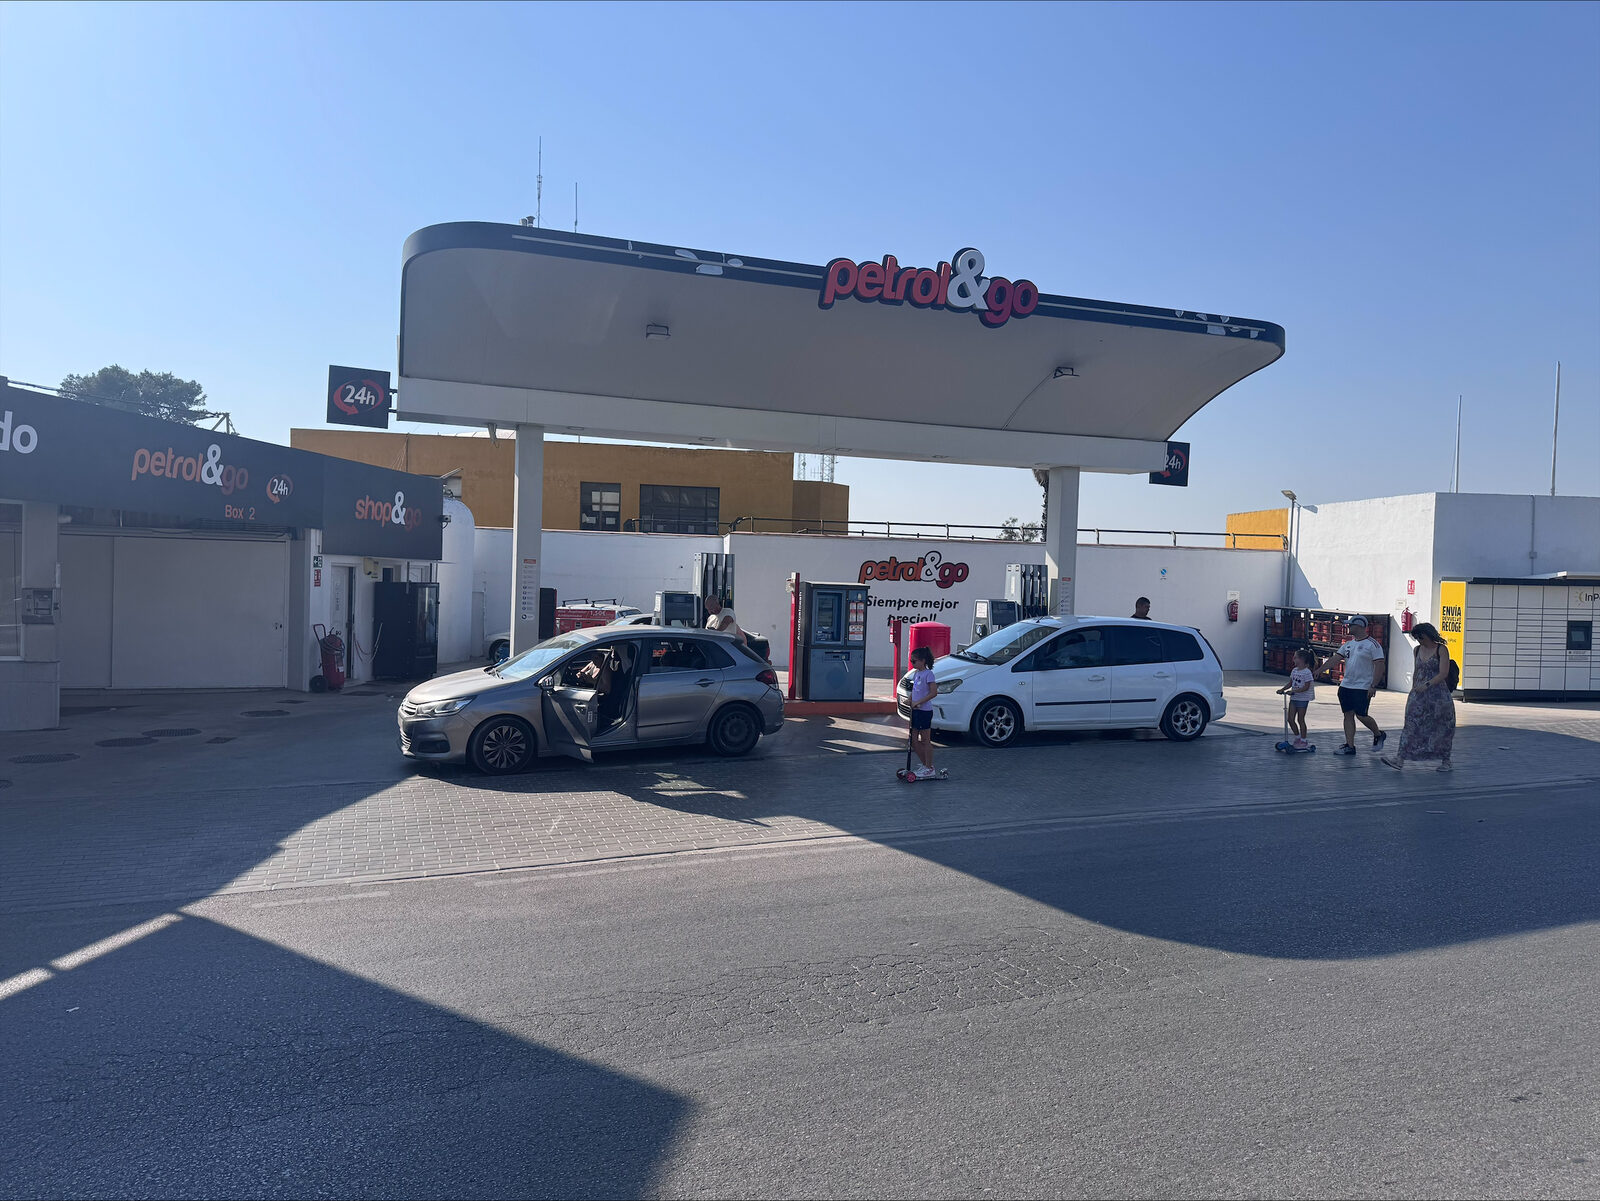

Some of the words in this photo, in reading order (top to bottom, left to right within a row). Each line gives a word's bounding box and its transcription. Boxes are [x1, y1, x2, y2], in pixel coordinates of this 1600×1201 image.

[819, 247, 1039, 328] petrol&go
[343, 385, 376, 406] 24h
[131, 444, 249, 496] petrol&go
[272, 479, 289, 496] 24h
[225, 504, 244, 520] Box
[249, 507, 256, 520] 2
[355, 491, 422, 533] shop&go
[858, 550, 969, 589] petrol&go
[866, 595, 918, 611] Siempre
[920, 598, 959, 612] mejor
